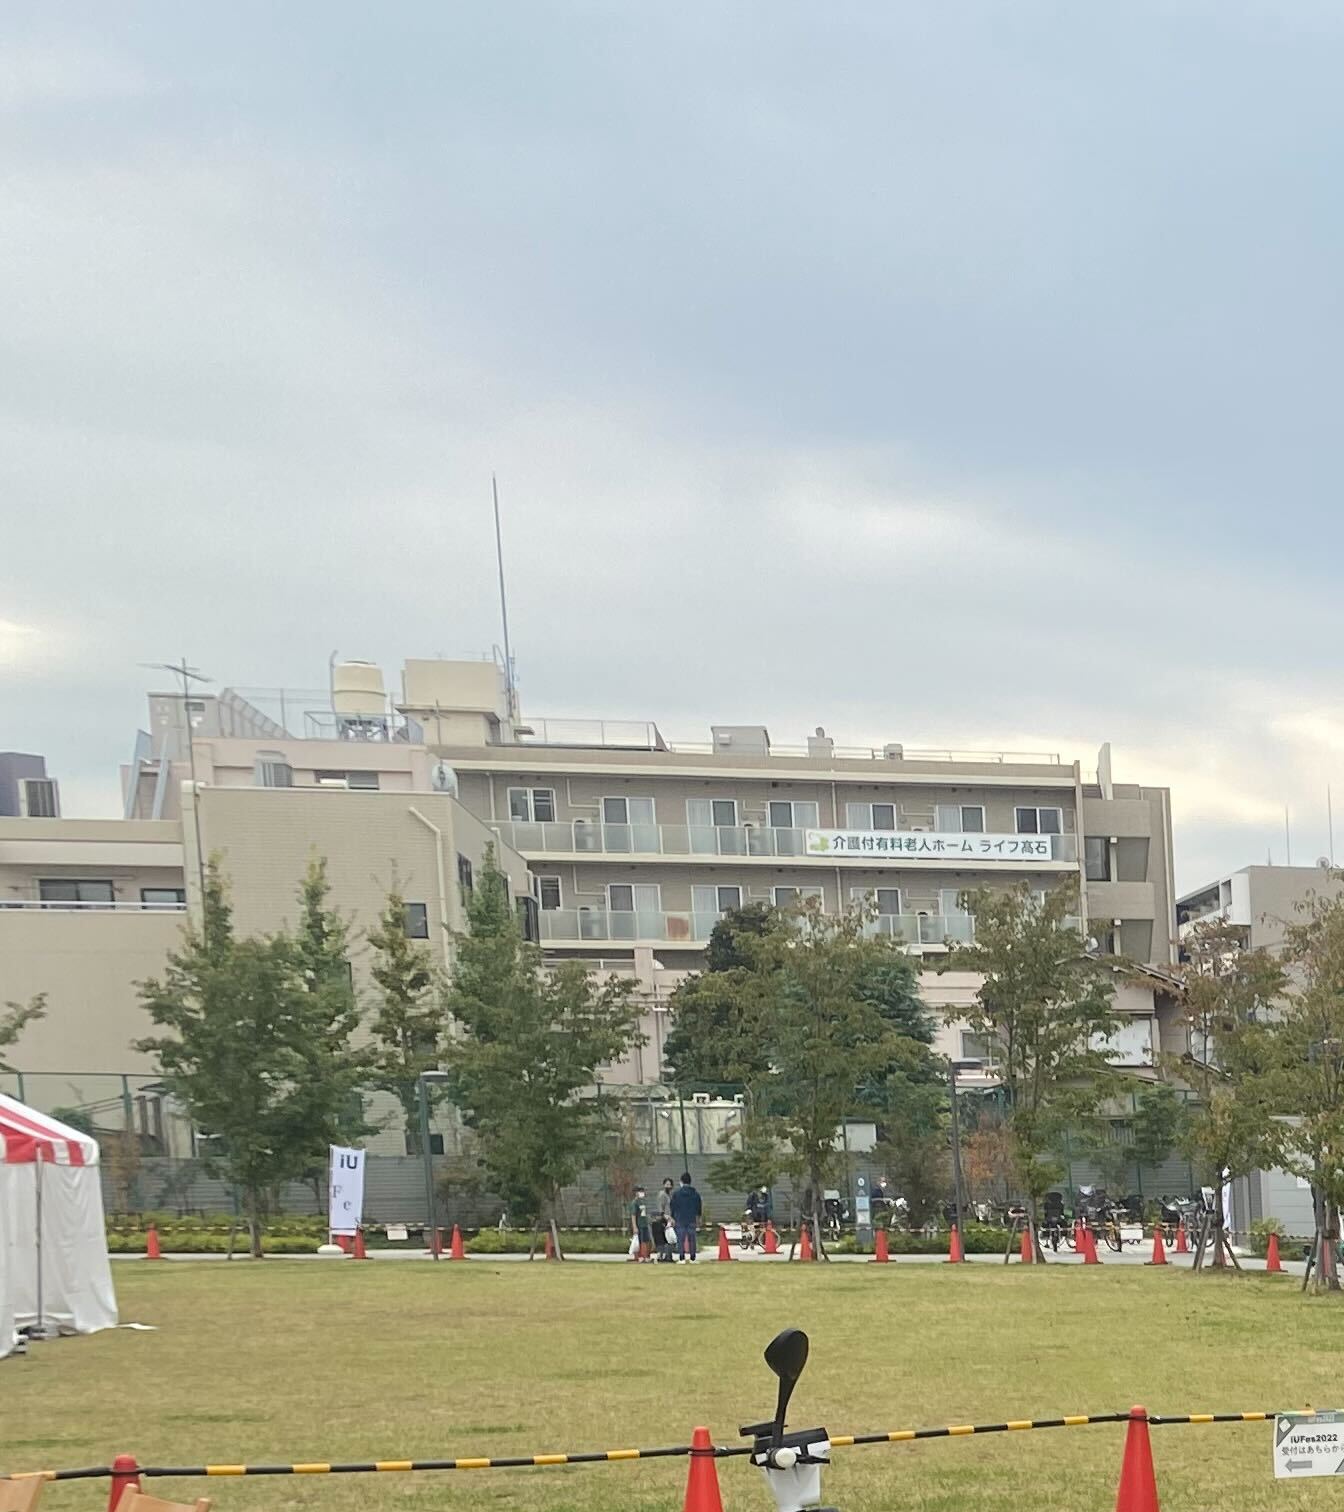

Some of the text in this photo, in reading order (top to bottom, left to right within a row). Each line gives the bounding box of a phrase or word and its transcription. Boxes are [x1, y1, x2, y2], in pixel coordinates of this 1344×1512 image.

[833, 834, 973, 852] 介護付有料老人ホーム
[340, 1154, 358, 1169] iU
